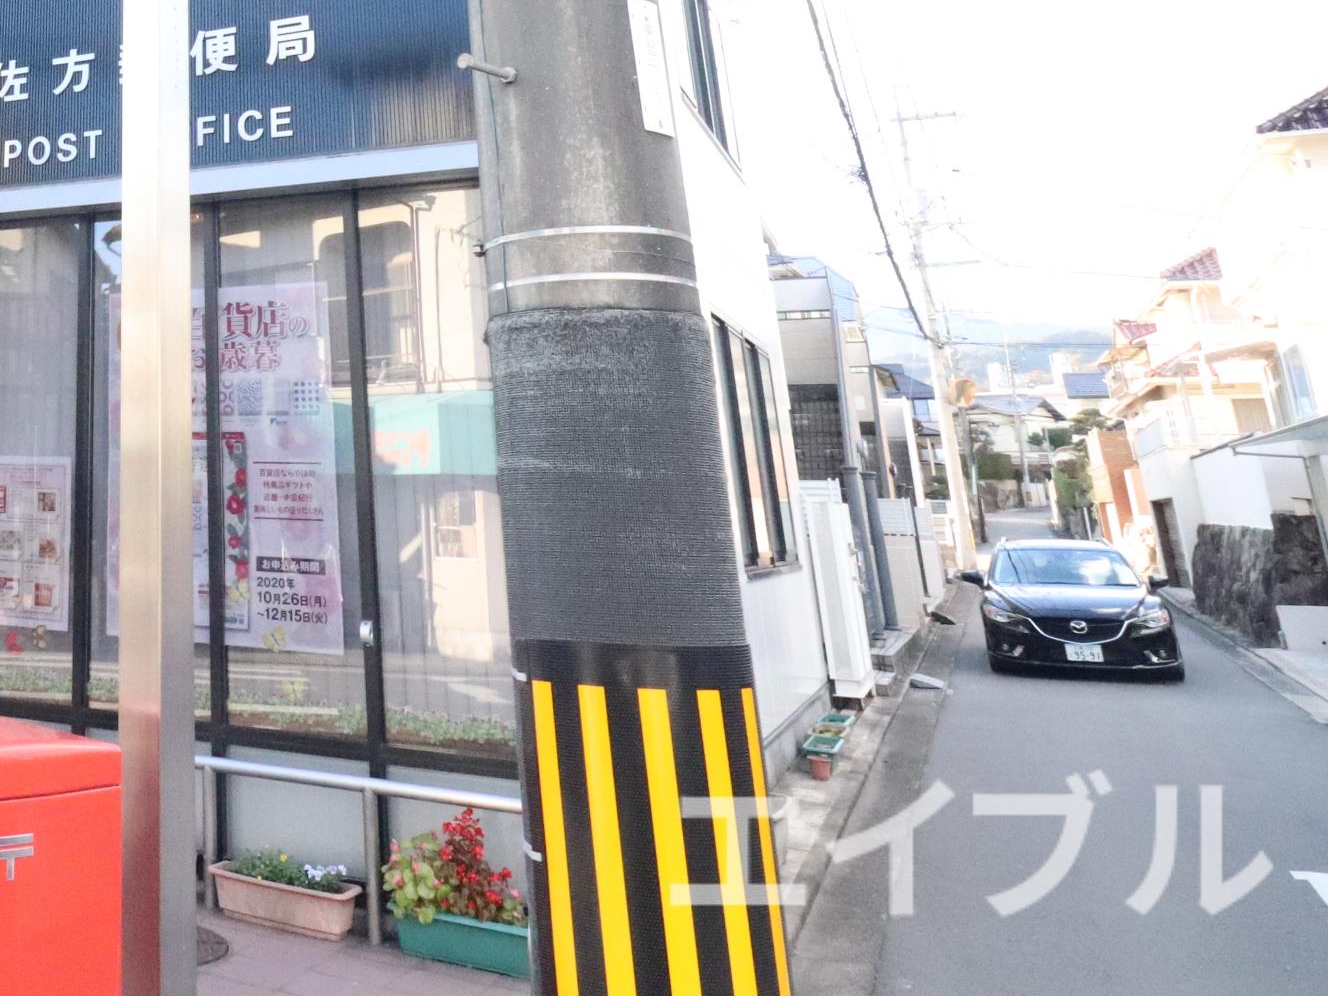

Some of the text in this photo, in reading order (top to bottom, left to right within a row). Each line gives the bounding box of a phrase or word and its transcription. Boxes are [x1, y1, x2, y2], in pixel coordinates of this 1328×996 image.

[3, 105, 295, 168] POST FICE
[256, 576, 295, 590] 2020年
